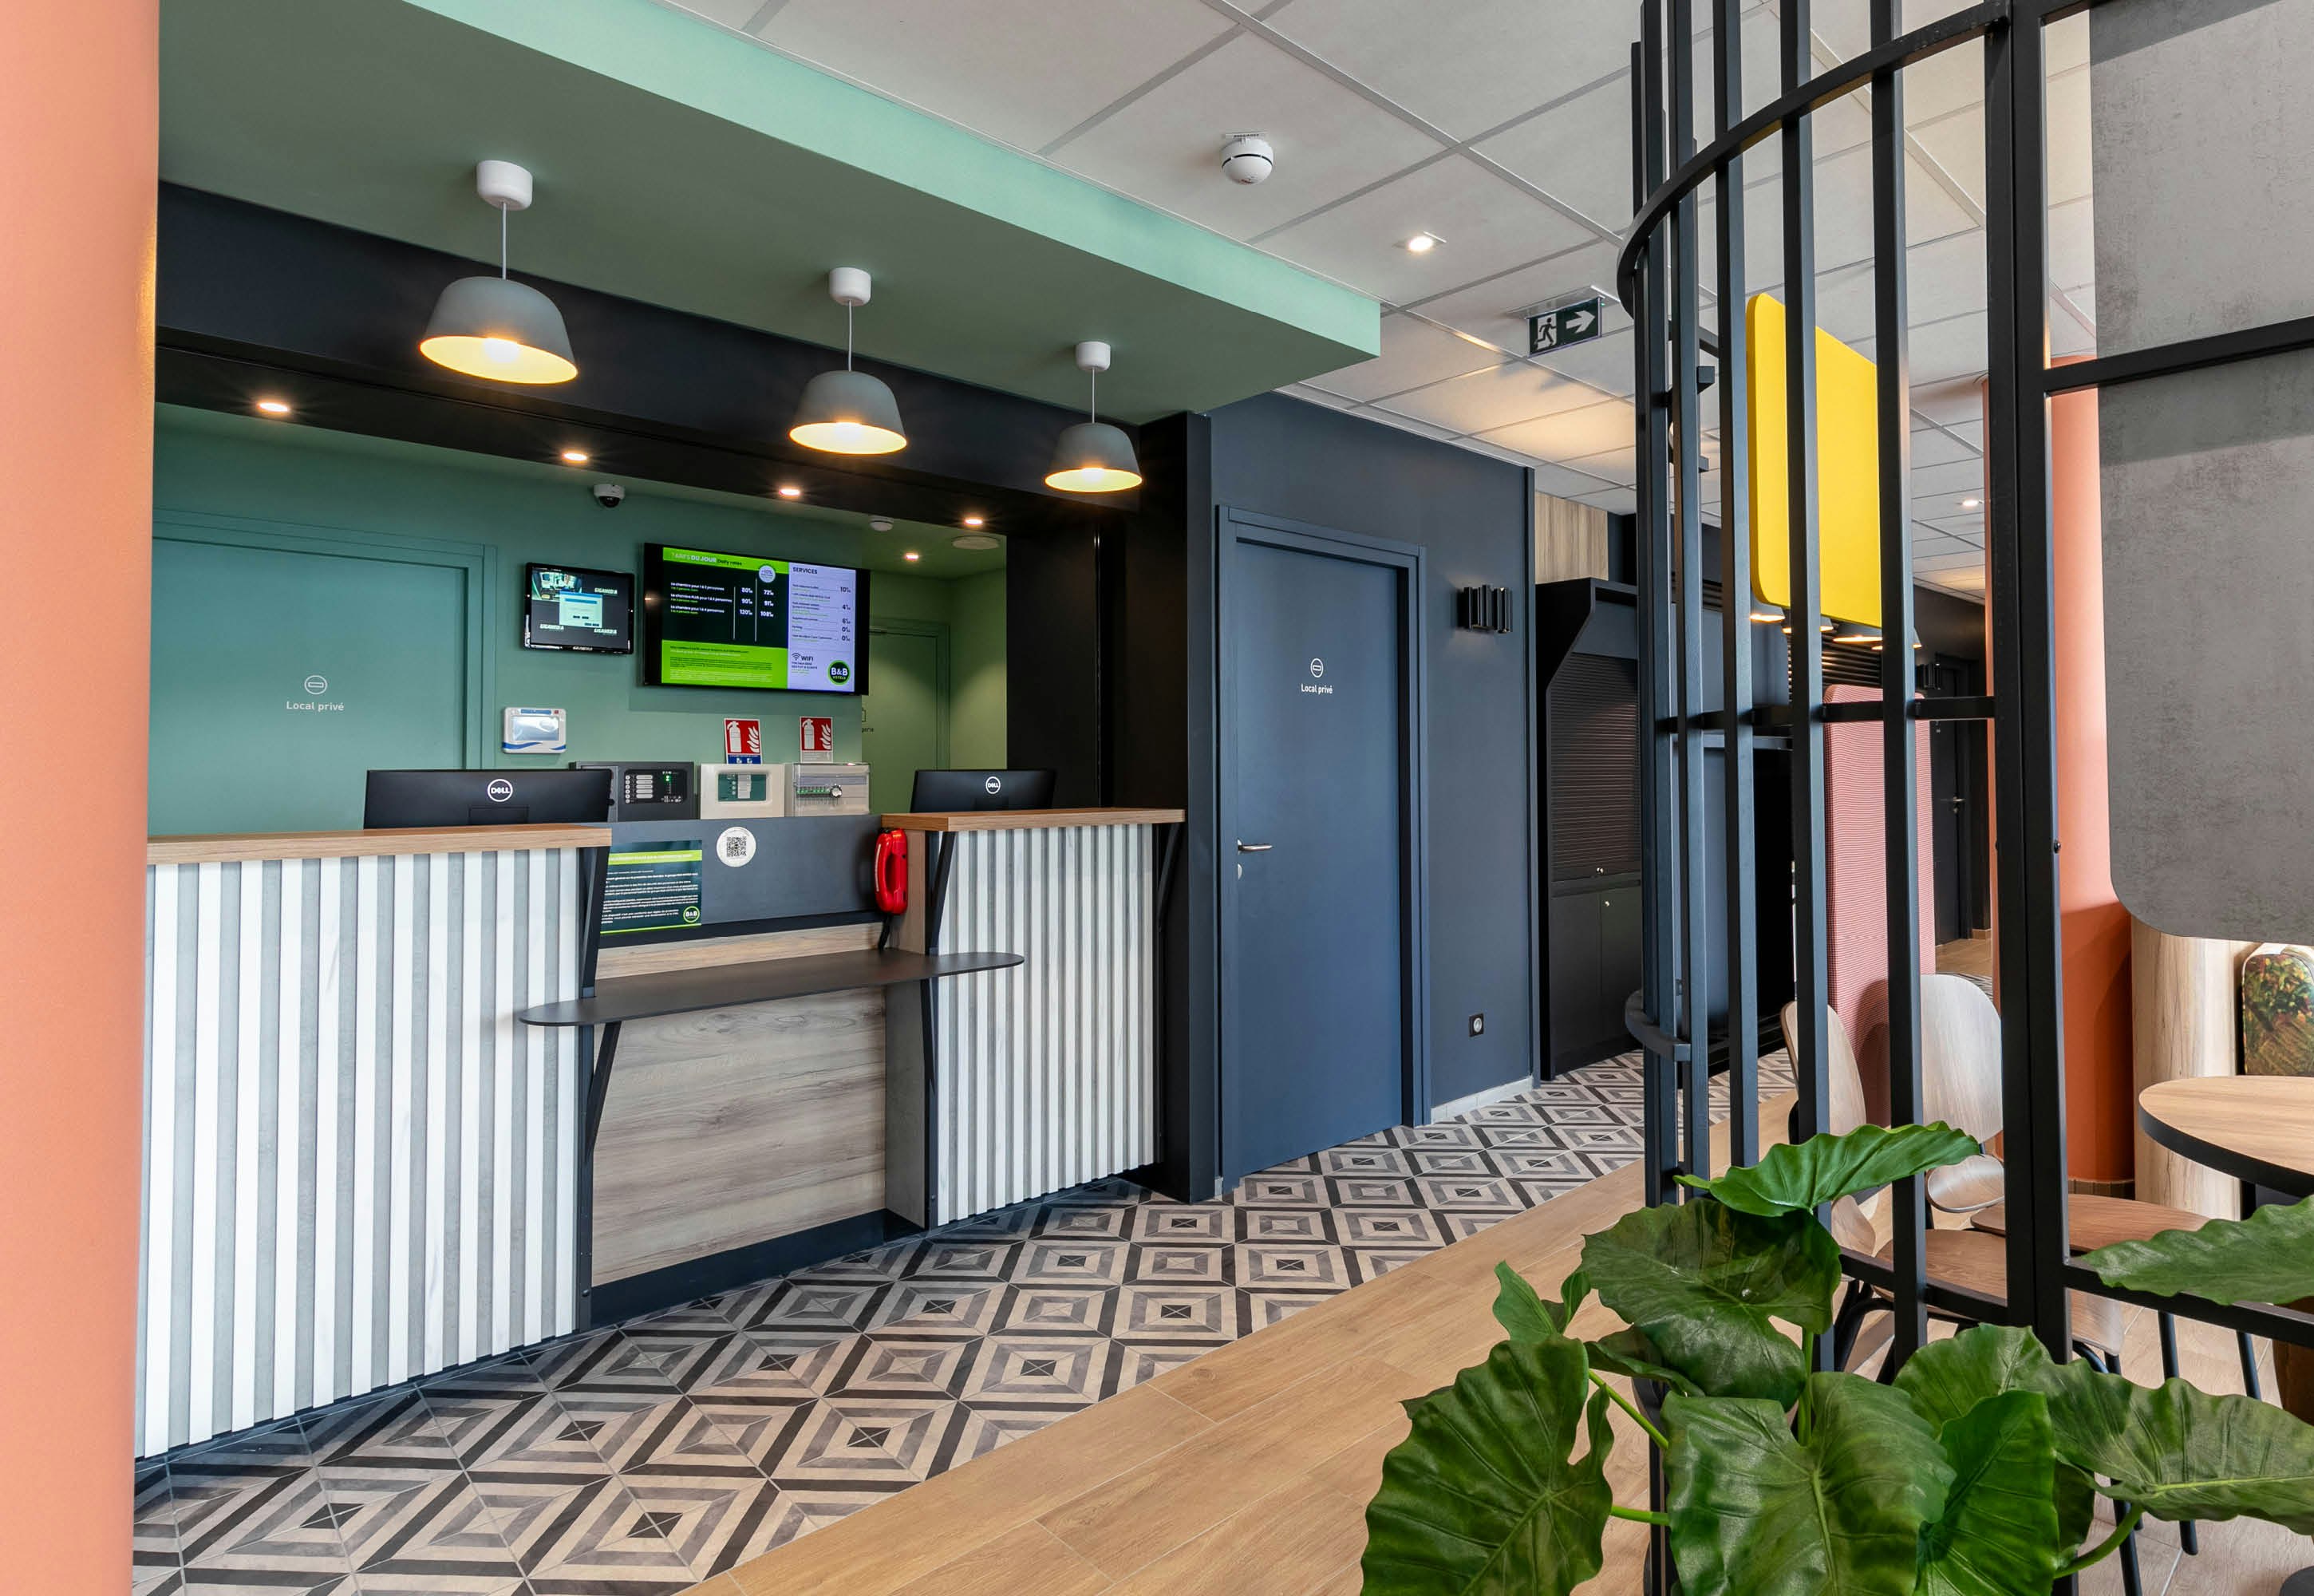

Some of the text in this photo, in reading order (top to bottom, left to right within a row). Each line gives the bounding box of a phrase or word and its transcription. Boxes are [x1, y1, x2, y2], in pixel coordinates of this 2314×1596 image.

[831, 667, 848, 676] B&B
[1301, 683, 1333, 695] Local privé
[286, 701, 345, 713] Local privé
